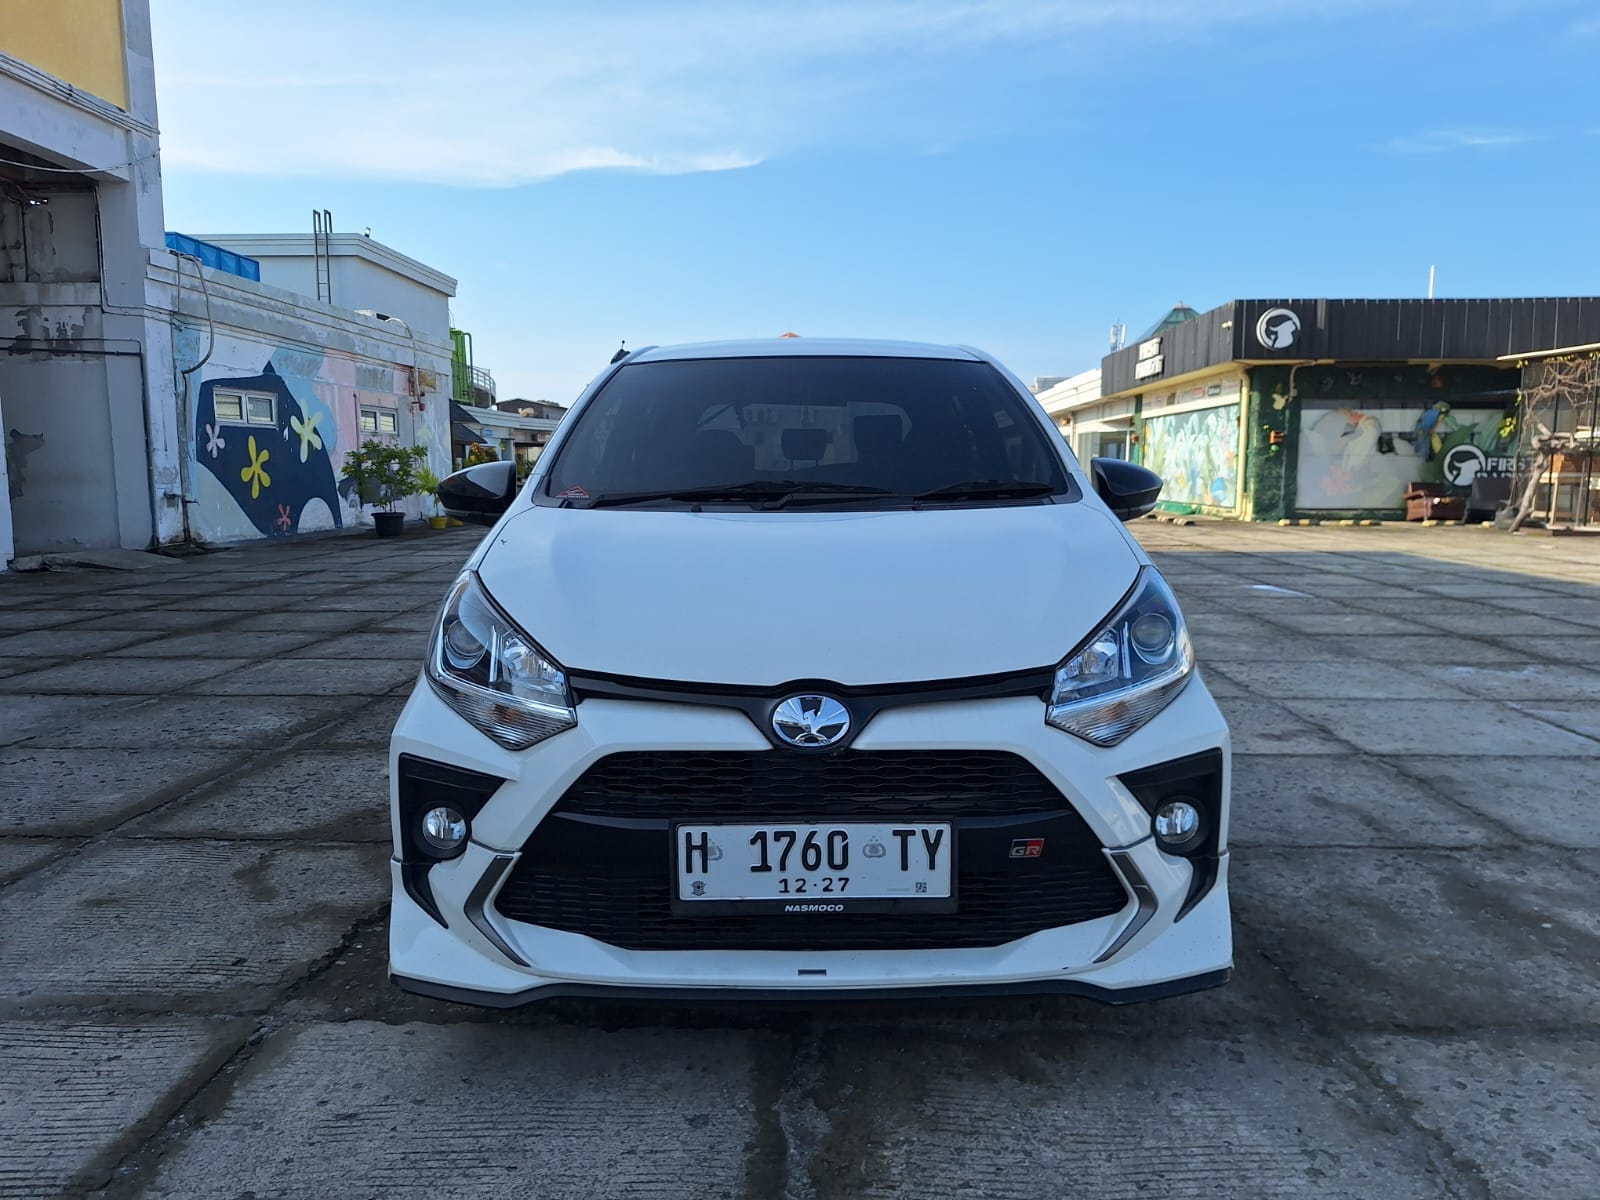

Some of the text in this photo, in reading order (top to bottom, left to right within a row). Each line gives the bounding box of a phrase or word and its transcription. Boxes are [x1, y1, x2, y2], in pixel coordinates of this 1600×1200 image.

[685, 829, 944, 874] H 1760 TY
[1012, 846, 1041, 856] GR
[784, 904, 844, 913] NASMOCO
